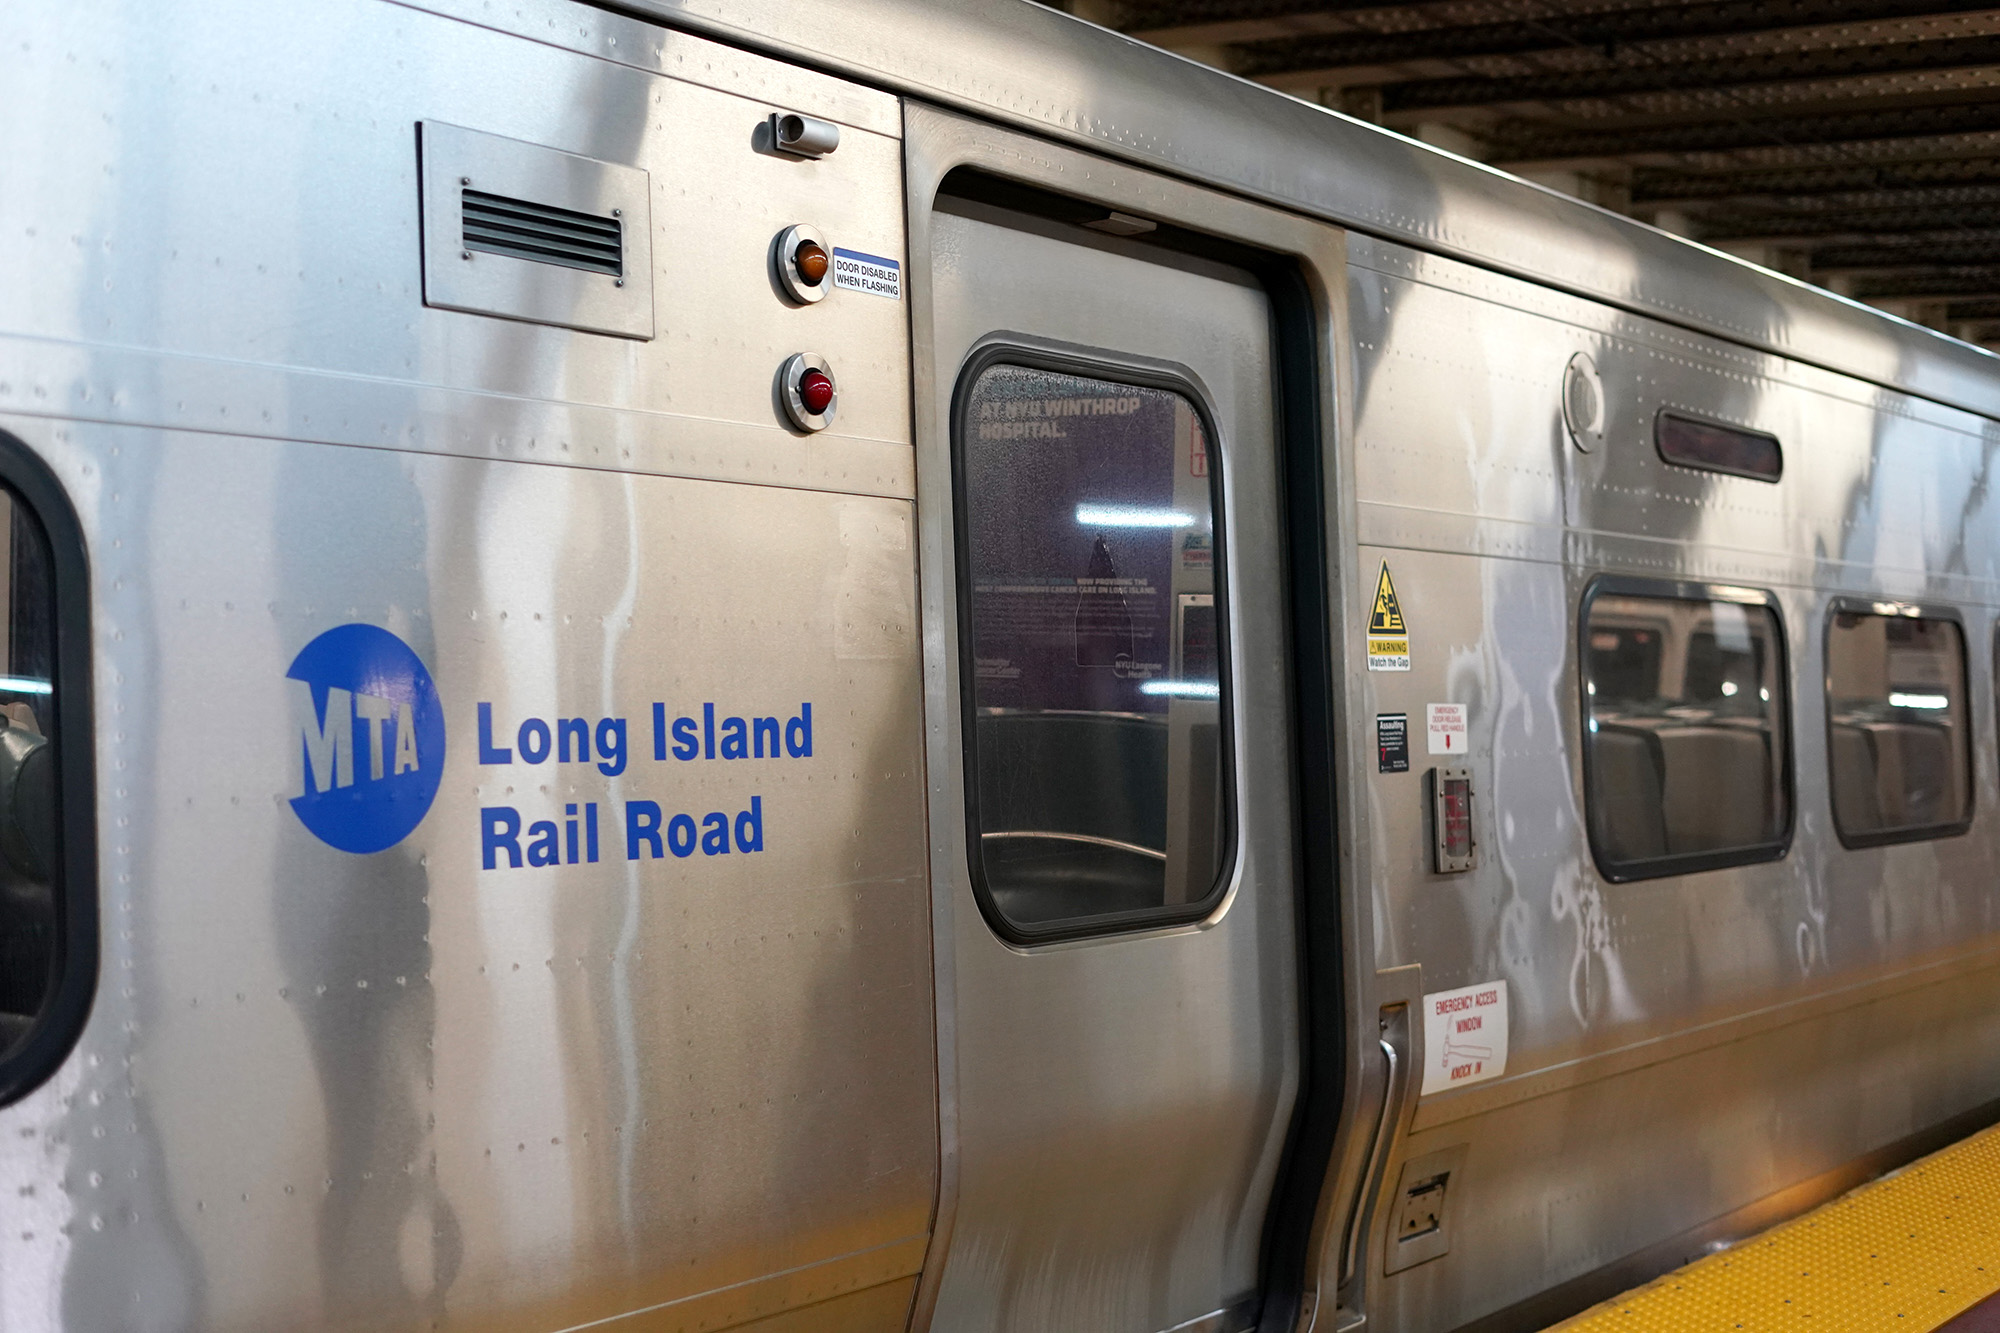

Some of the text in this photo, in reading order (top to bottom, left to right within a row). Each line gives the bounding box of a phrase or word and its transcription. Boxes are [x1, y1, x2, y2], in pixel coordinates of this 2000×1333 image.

[836, 260, 898, 283] DOOR DISABLED
[836, 273, 899, 295] WHEN FLASHING
[980, 401, 1001, 417] AT
[1045, 397, 1141, 416] WINTHROP
[978, 421, 1067, 440] HOSPITAL.
[1376, 642, 1407, 653] WARNING
[1115, 661, 1131, 669] NYU
[1369, 656, 1409, 669] Watch the Gap
[1379, 720, 1404, 731] Assaulting
[284, 677, 420, 801] MTA
[477, 701, 813, 777] Long Island
[1380, 747, 1387, 761] 7
[480, 795, 765, 871] Rail Road
[1436, 990, 1497, 1015] EMERGENCY ACCESS
[1456, 1016, 1482, 1033] WINDOW
[1450, 1061, 1482, 1080] KNOCK IN
